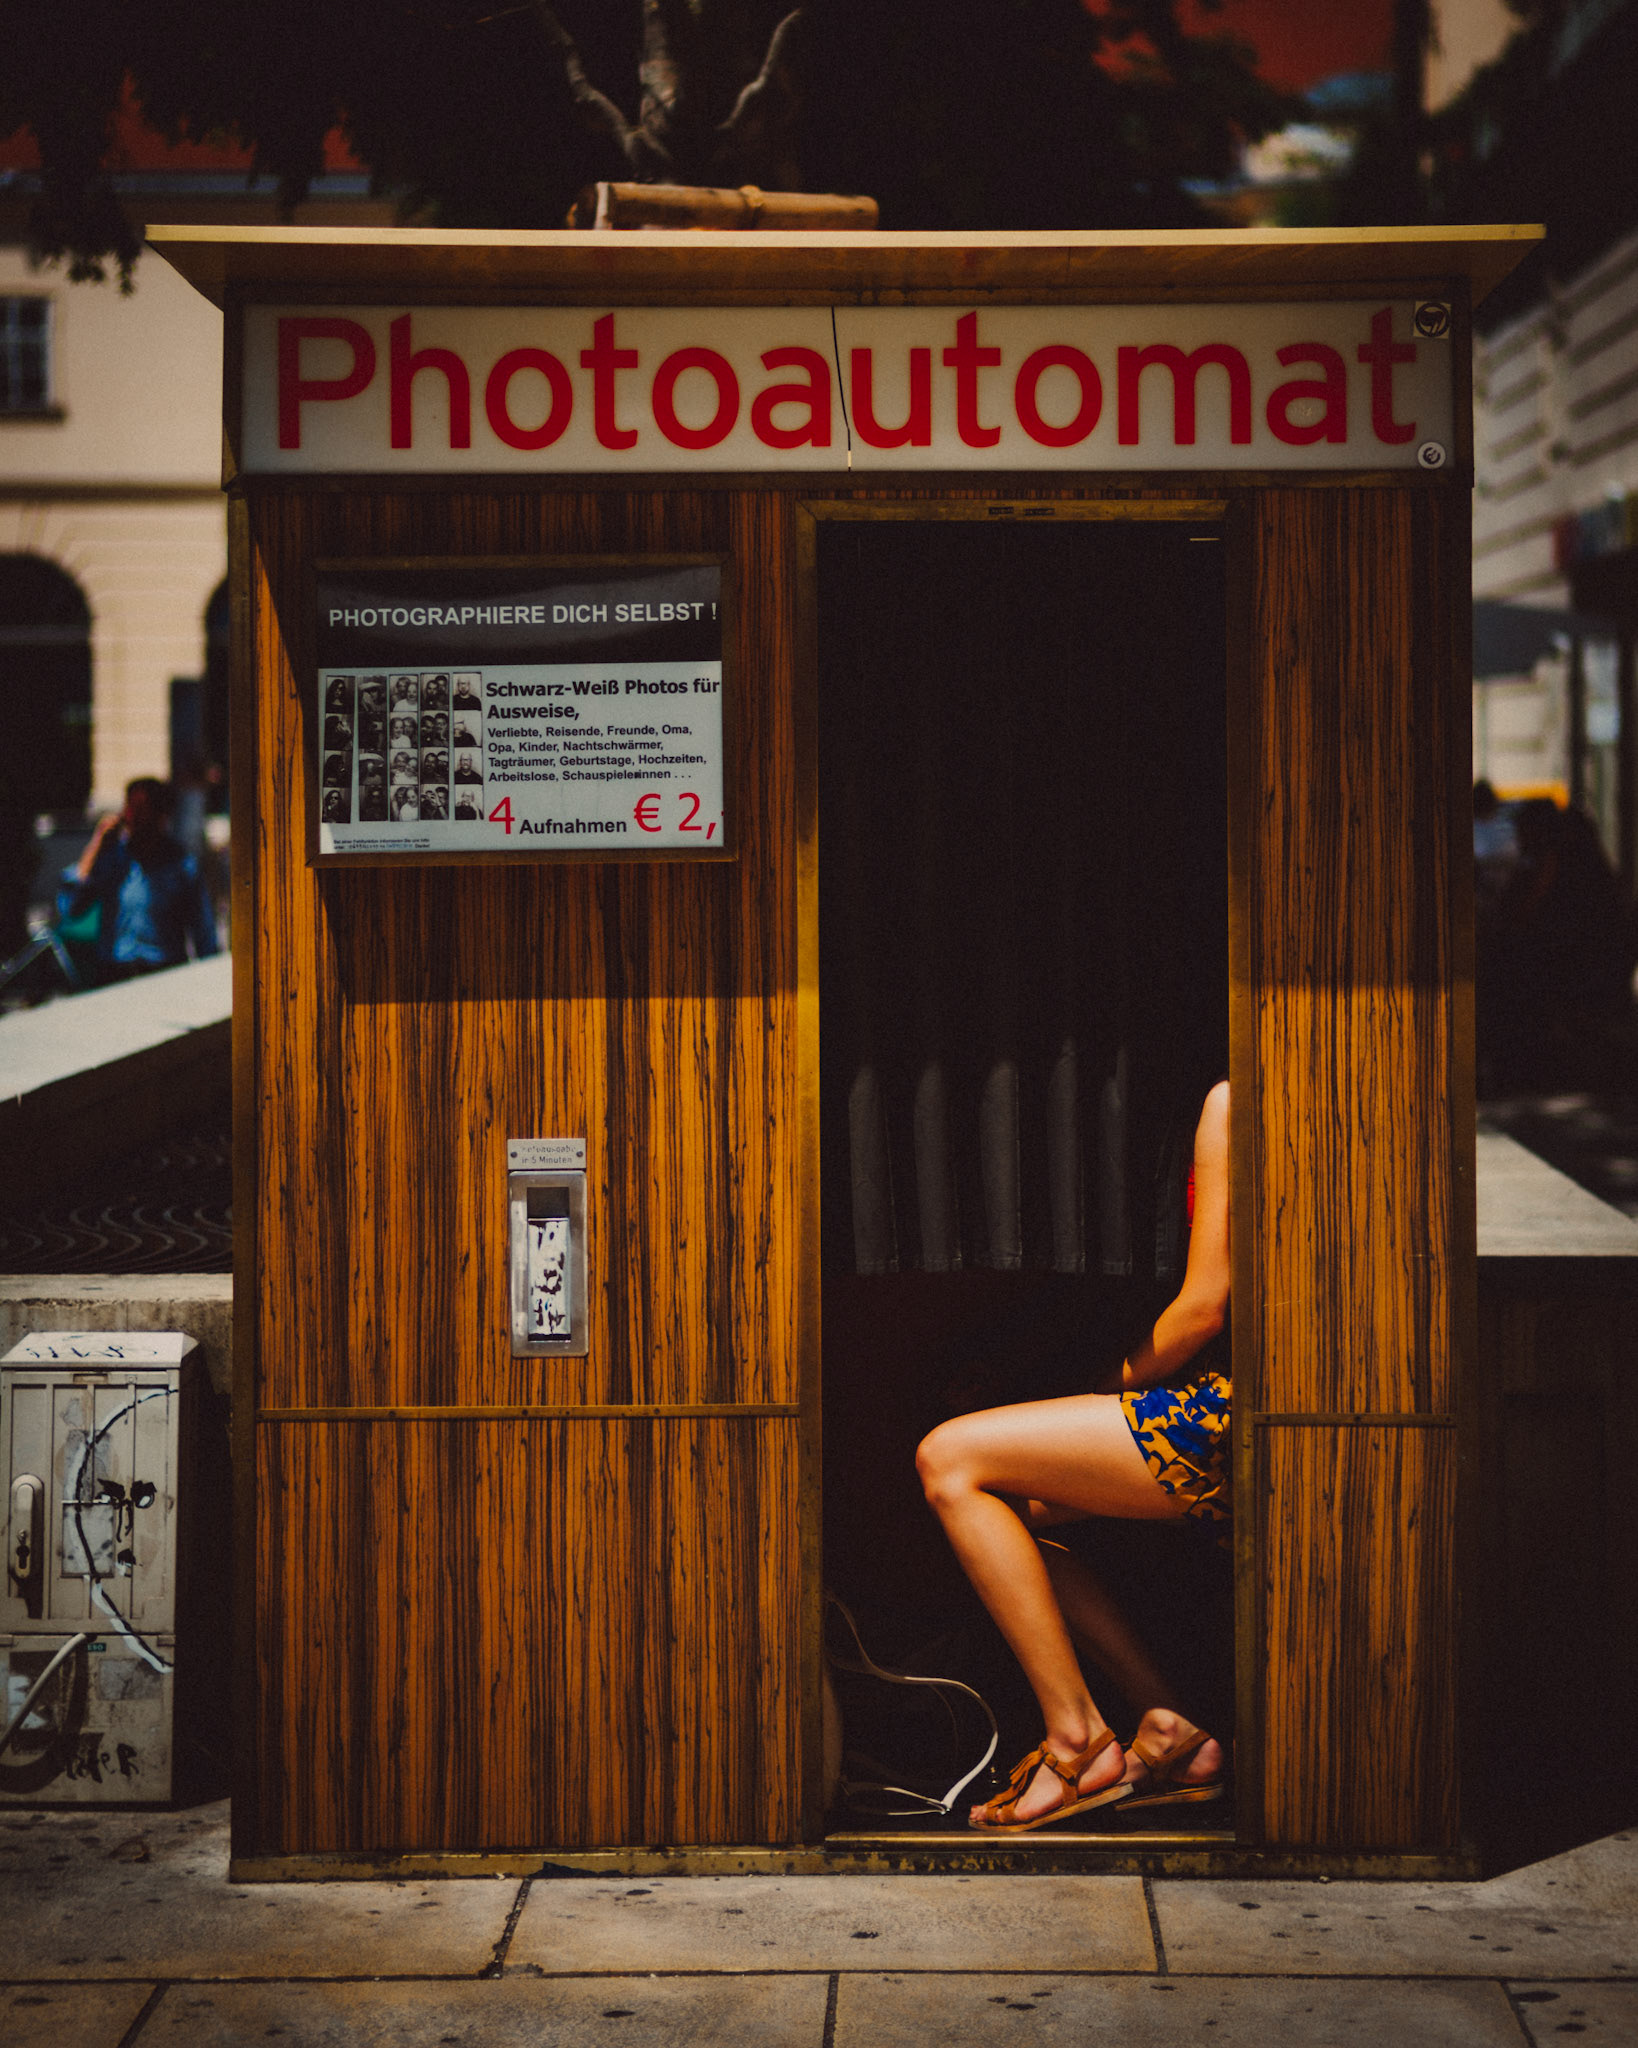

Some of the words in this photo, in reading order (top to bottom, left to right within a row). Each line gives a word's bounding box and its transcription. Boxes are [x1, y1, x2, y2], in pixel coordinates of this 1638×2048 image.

[276, 307, 1418, 450] Photoautomat
[329, 606, 545, 627] PHOTOGRAPHIERE
[553, 604, 607, 624] DICH
[615, 602, 704, 622] SELBST
[486, 679, 619, 697] Schwarz-Weiß
[625, 679, 688, 695] Photos
[693, 678, 720, 693] für
[487, 703, 580, 721] Ausweise,
[487, 727, 542, 738] Verliebte,
[546, 726, 603, 738] Reisende,
[607, 725, 658, 737] Freunde,
[662, 724, 692, 736] Oma,
[488, 742, 515, 754] Opa,
[519, 741, 559, 753] Kinder,
[563, 740, 664, 752] Nachtschwärmer,
[489, 757, 556, 770] Tagträumer,
[559, 756, 635, 768] Geburtstage,
[638, 754, 707, 765] Hochzeiten,
[489, 772, 559, 782] Arbeitslose,
[488, 796, 515, 834] 4
[520, 818, 627, 835] Aufnahmen
[633, 793, 662, 833] €
